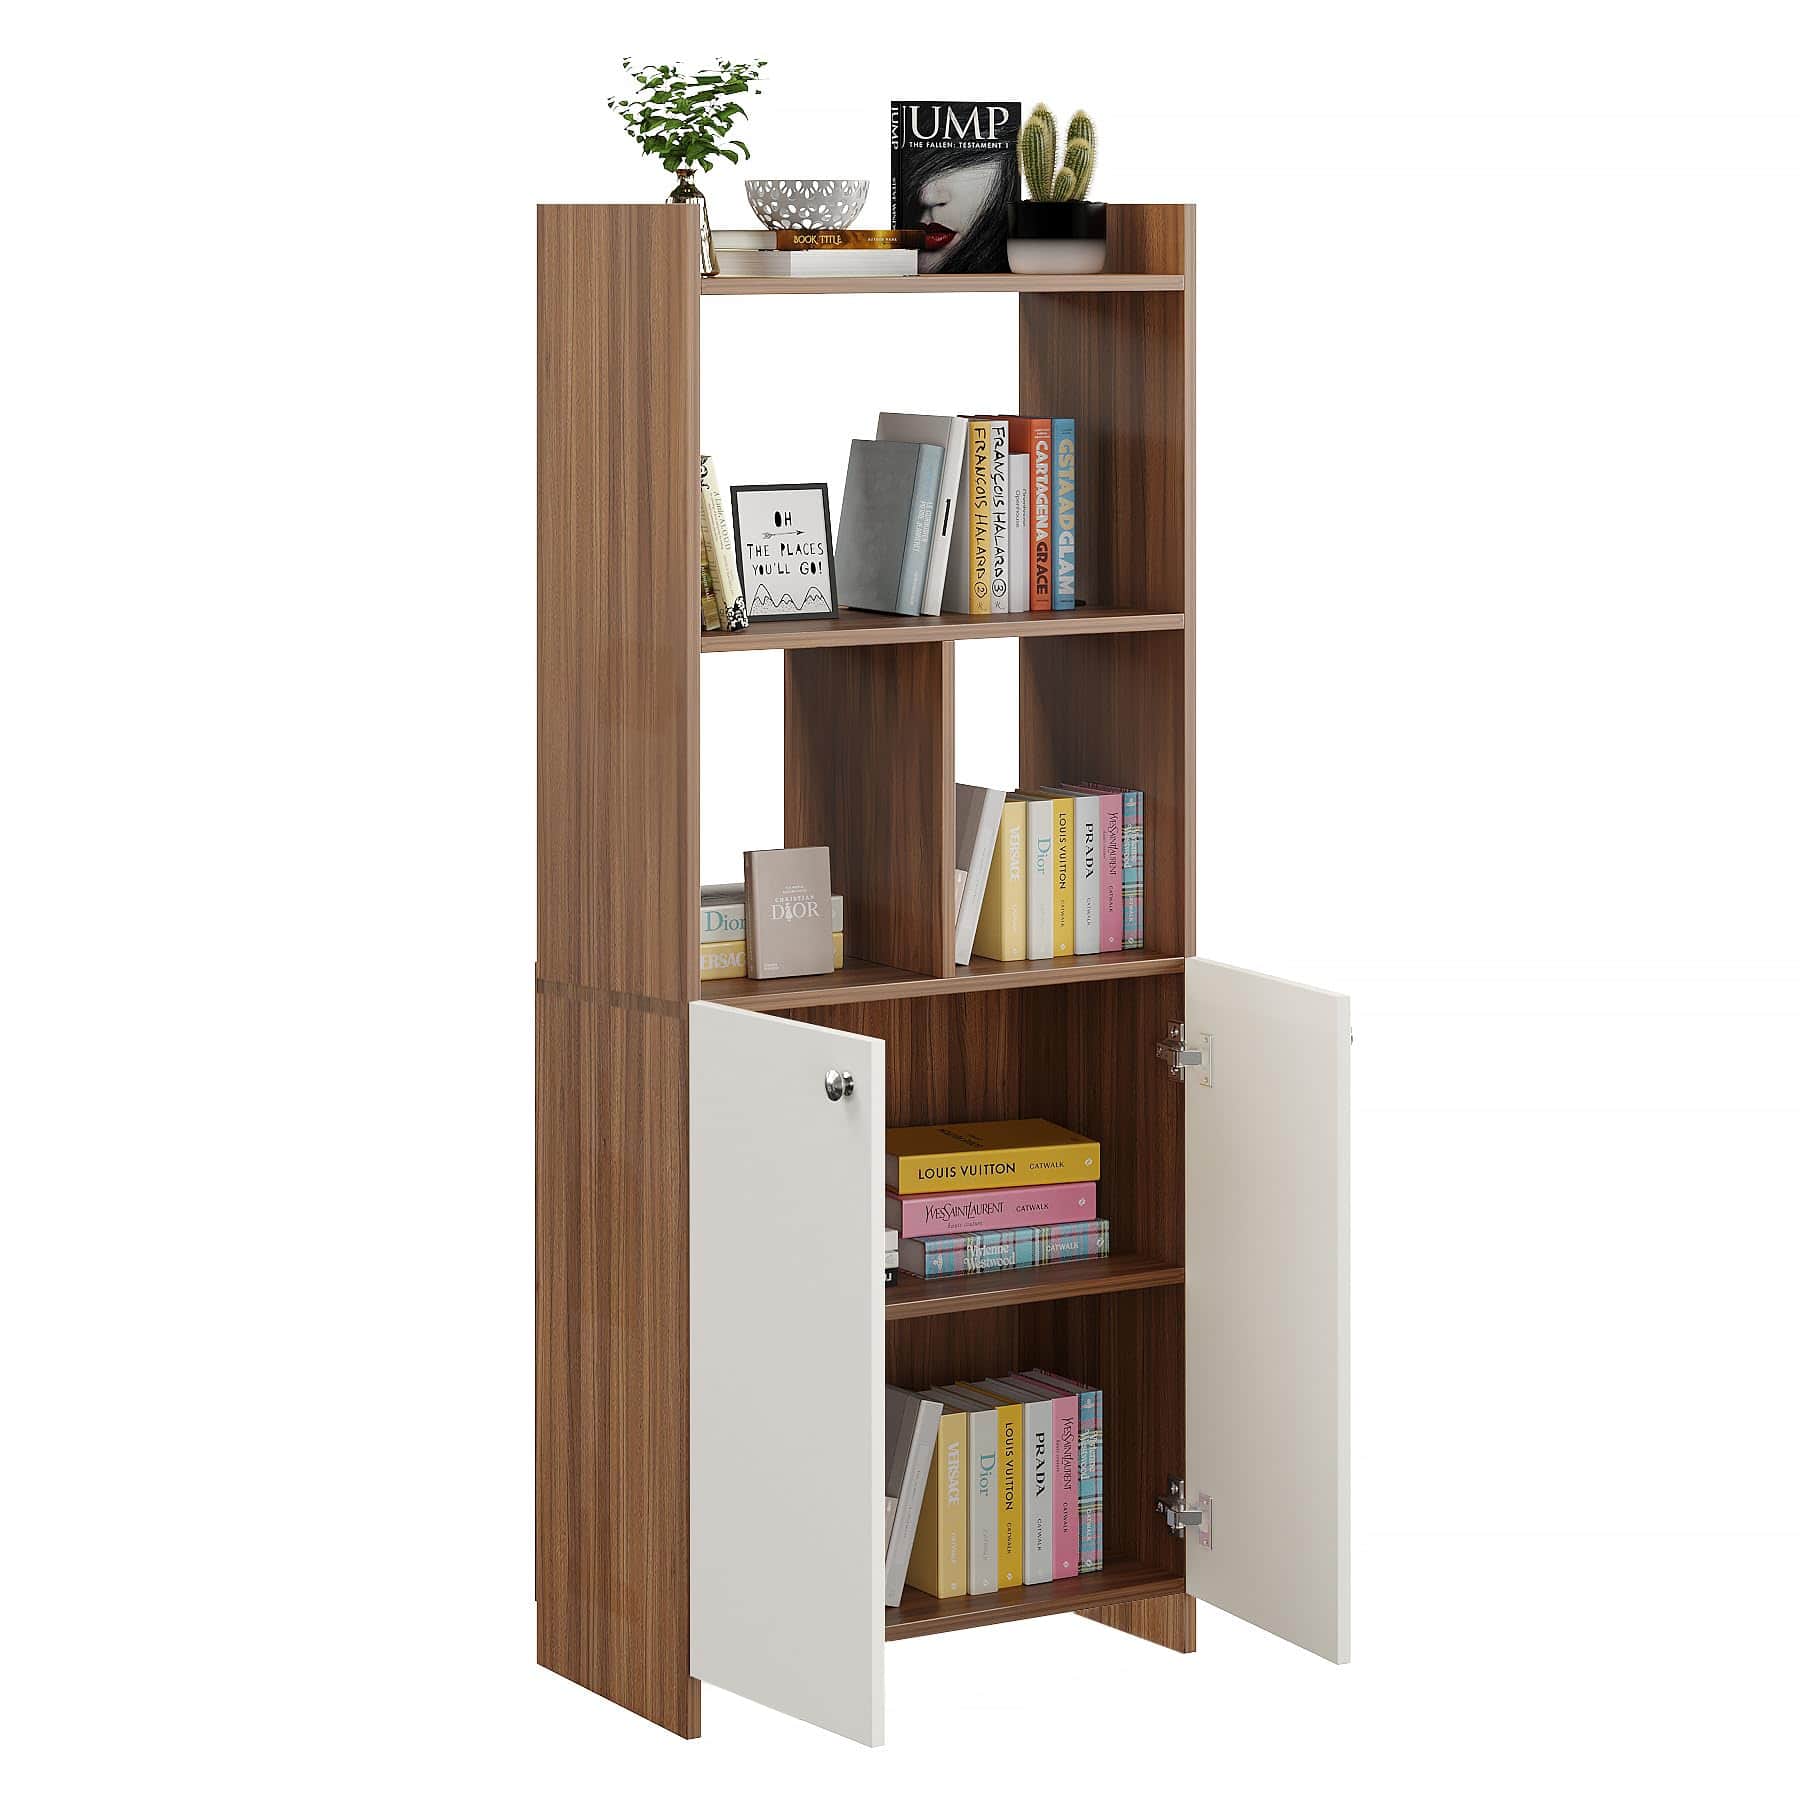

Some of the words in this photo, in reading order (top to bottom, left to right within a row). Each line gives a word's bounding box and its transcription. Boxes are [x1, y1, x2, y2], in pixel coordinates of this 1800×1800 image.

[891, 106, 899, 150] JUMP
[901, 105, 1009, 149] JUMP
[793, 235, 819, 245] BOOK
[819, 235, 843, 245] TITLE
[774, 511, 792, 528] OH
[746, 543, 769, 560] THE
[780, 542, 824, 558] PLACES
[974, 513, 988, 580] HALARD
[991, 511, 1007, 579] HALARD
[752, 562, 791, 576] YOU'LL
[799, 561, 823, 575] GO!
[1059, 813, 1067, 843] LOUIS
[1036, 835, 1051, 876] Dior
[1059, 845, 1067, 889] VUITTON
[1085, 823, 1094, 879] PRADA
[700, 951, 746, 971] ERSAC
[918, 1166, 957, 1181] LOUIS
[960, 1162, 1016, 1178] VUITTON
[1029, 1161, 1065, 1170] CATWALK
[1015, 1203, 1049, 1213] CATWALK
[1004, 1422, 1014, 1457] LOUIS
[946, 1441, 960, 1505] VERSACE
[979, 1450, 997, 1497] Dior
[1005, 1459, 1014, 1511] VUITTON
[1035, 1432, 1046, 1497] PRADA
